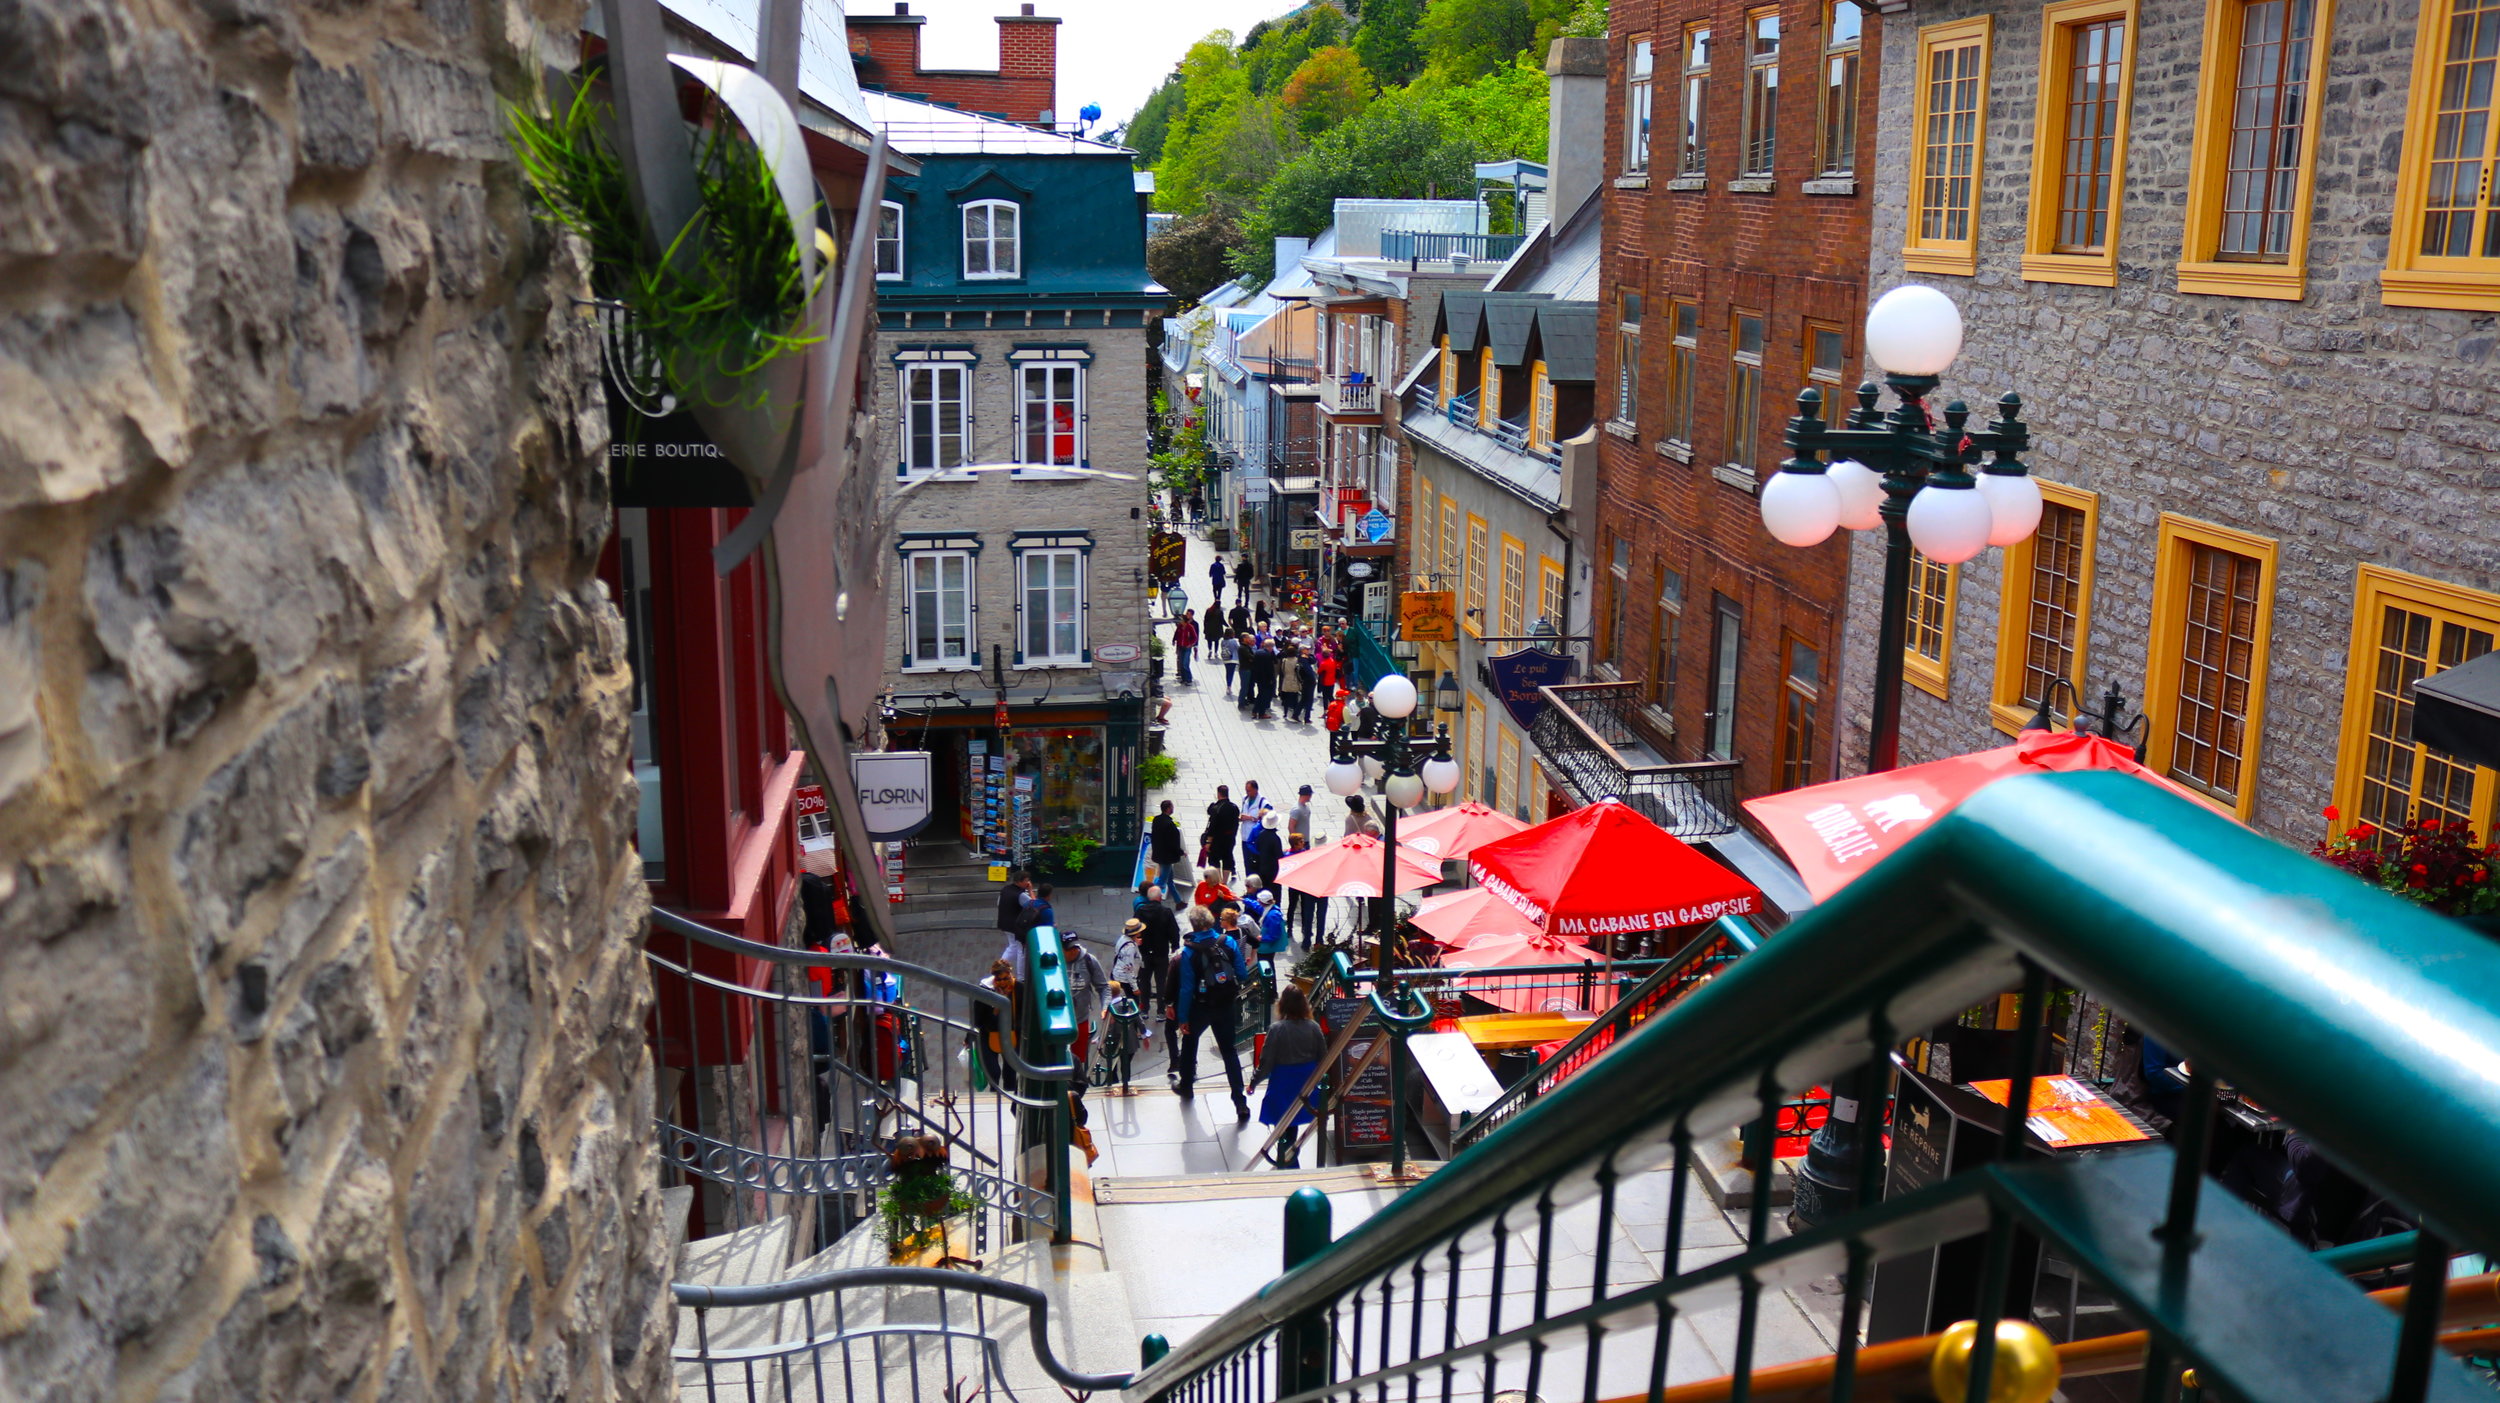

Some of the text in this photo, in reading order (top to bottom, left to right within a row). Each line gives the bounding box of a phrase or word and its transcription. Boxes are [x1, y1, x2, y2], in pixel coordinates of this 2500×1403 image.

[606, 444, 647, 457] ERIE
[1403, 606, 1429, 621] Louis
[1512, 663, 1549, 674] Le pub
[1522, 677, 1538, 688] des
[860, 788, 925, 805] FLORIN
[1484, 874, 1522, 906] CABANE
[1559, 896, 1752, 934] MA CABANE EN GASPÉSIE
[1899, 1119, 1941, 1165] LE REPAIRE
